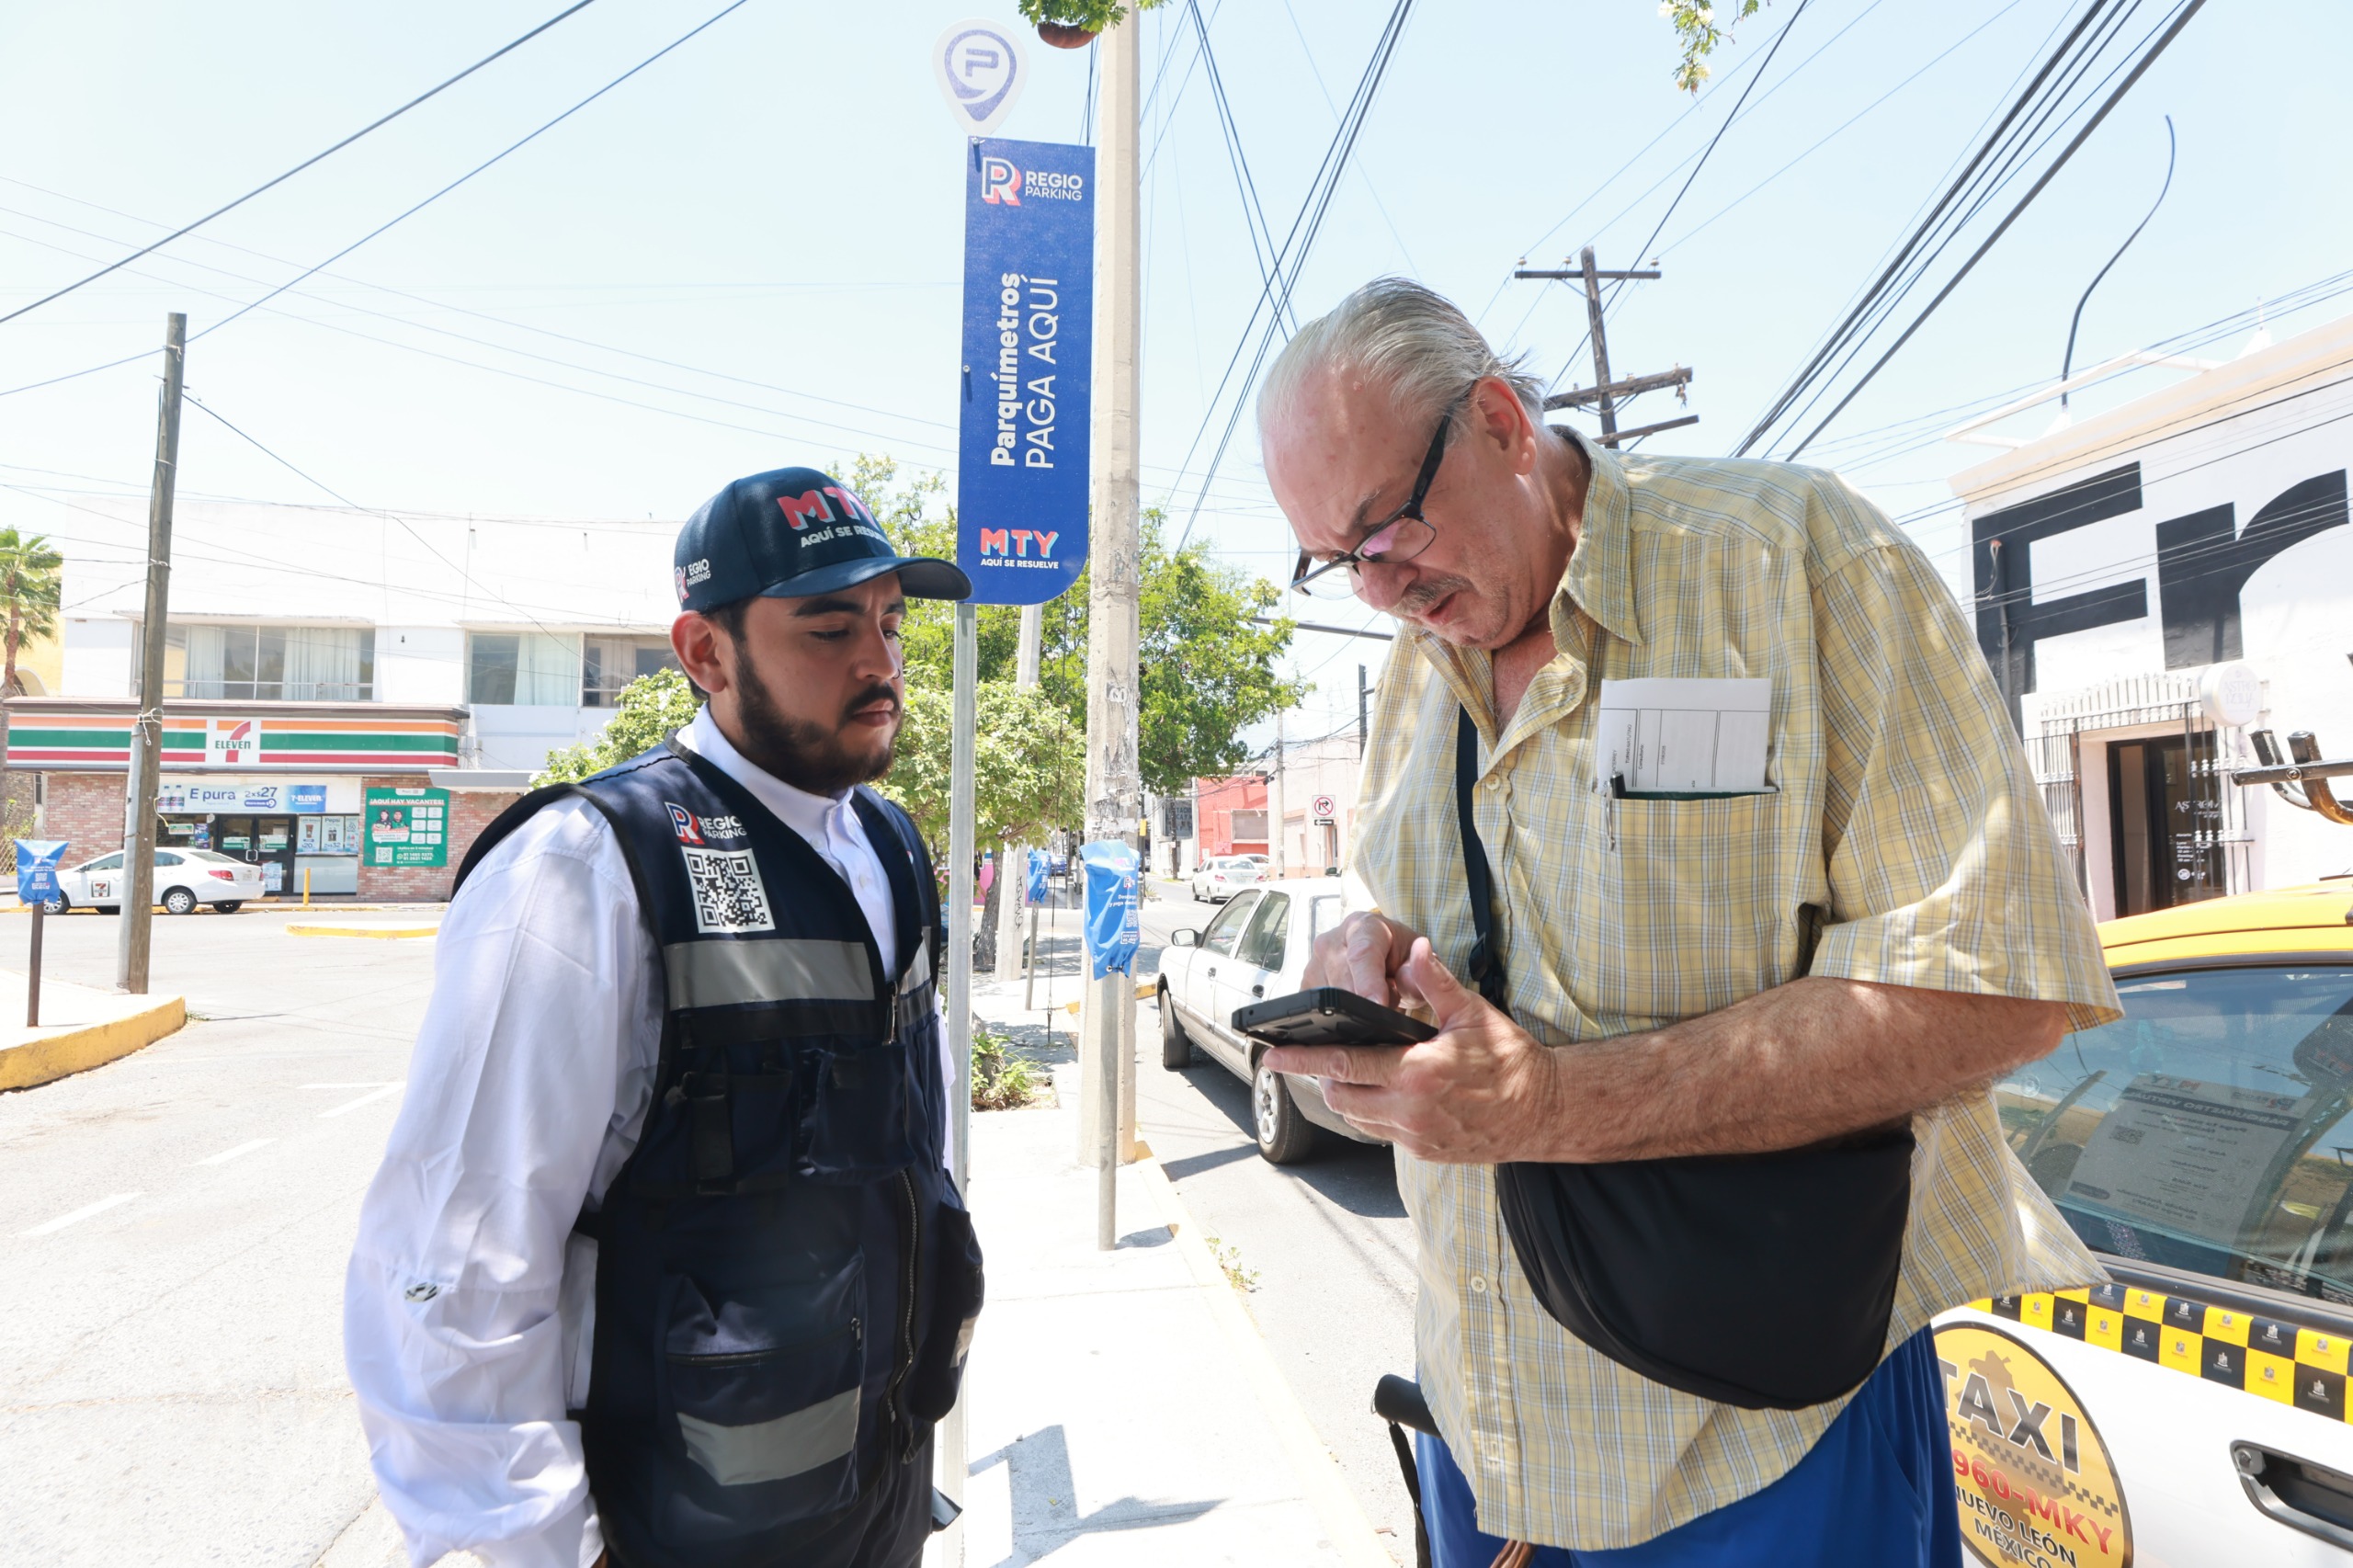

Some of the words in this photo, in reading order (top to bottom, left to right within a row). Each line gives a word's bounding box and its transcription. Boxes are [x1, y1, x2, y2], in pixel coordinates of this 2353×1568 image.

[965, 49, 999, 77] P
[1025, 170, 1083, 189] REGIO
[1025, 187, 1083, 201] PARKING
[1020, 274, 1059, 365] AQUÍ
[990, 272, 1022, 466] Parquímetros
[1026, 375, 1056, 468] PAGA
[801, 526, 835, 548] AQUÍ
[835, 526, 853, 537] SE
[980, 528, 1060, 558] MTY
[688, 558, 710, 576] EGIO
[980, 557, 1003, 567] AQUÍ
[1004, 559, 1015, 567] SE
[1017, 560, 1059, 569] RESUELVE
[686, 570, 711, 587] PARKING
[189, 788, 199, 800] E
[202, 790, 236, 801] pura
[696, 815, 742, 828] REGIO
[703, 827, 748, 840] PARKING
[1936, 1358, 2081, 1475] TAXI
[1951, 1449, 2113, 1555] 960-MKY
[1974, 1518, 2052, 1568] MÉXICO
[2019, 1521, 2077, 1568] LEÓN
